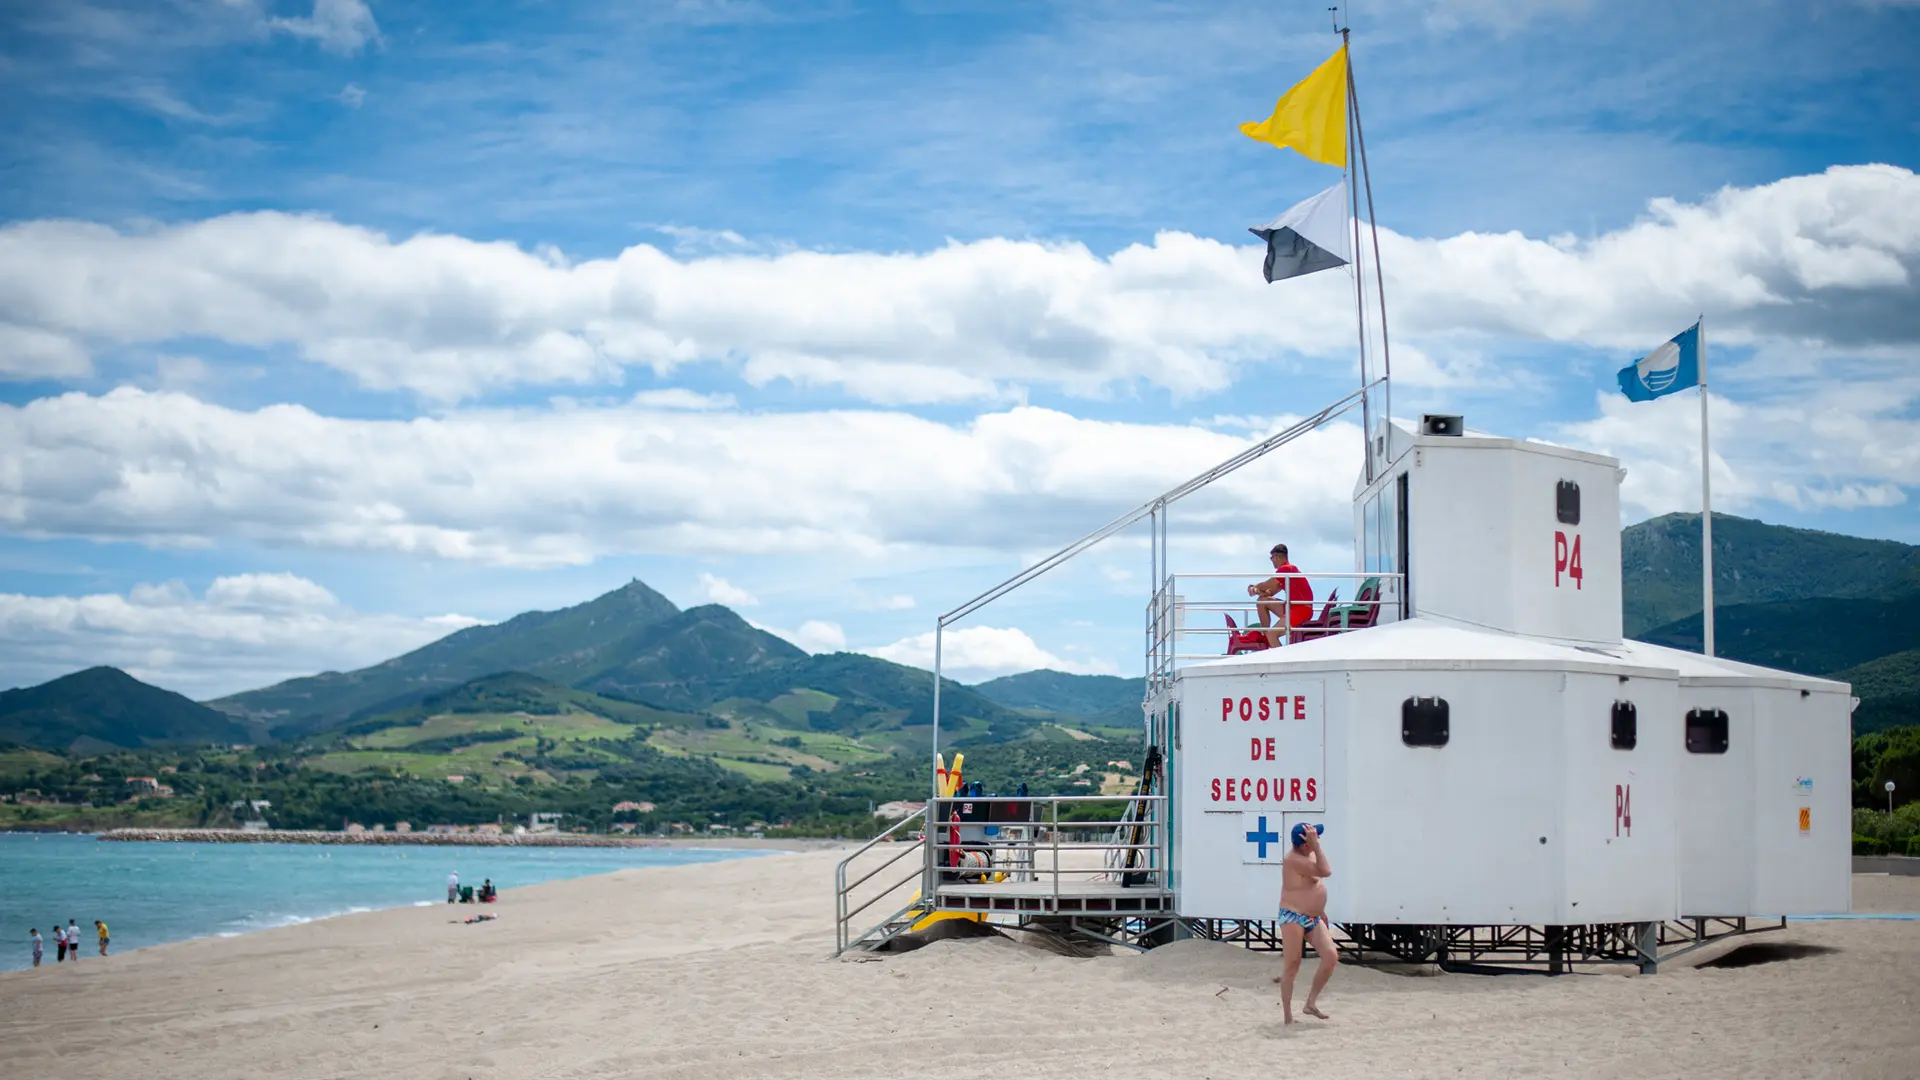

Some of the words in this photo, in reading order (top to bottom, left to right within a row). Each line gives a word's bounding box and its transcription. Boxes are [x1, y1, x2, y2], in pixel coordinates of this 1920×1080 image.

[1555, 531, 1583, 590] P4
[1222, 695, 1306, 721] POSTE
[1251, 738, 1275, 761] DE
[1137, 784, 1148, 815] RECUE
[1211, 778, 1317, 801] SECOURS
[963, 804, 973, 812] P4
[1616, 784, 1631, 837] P4
